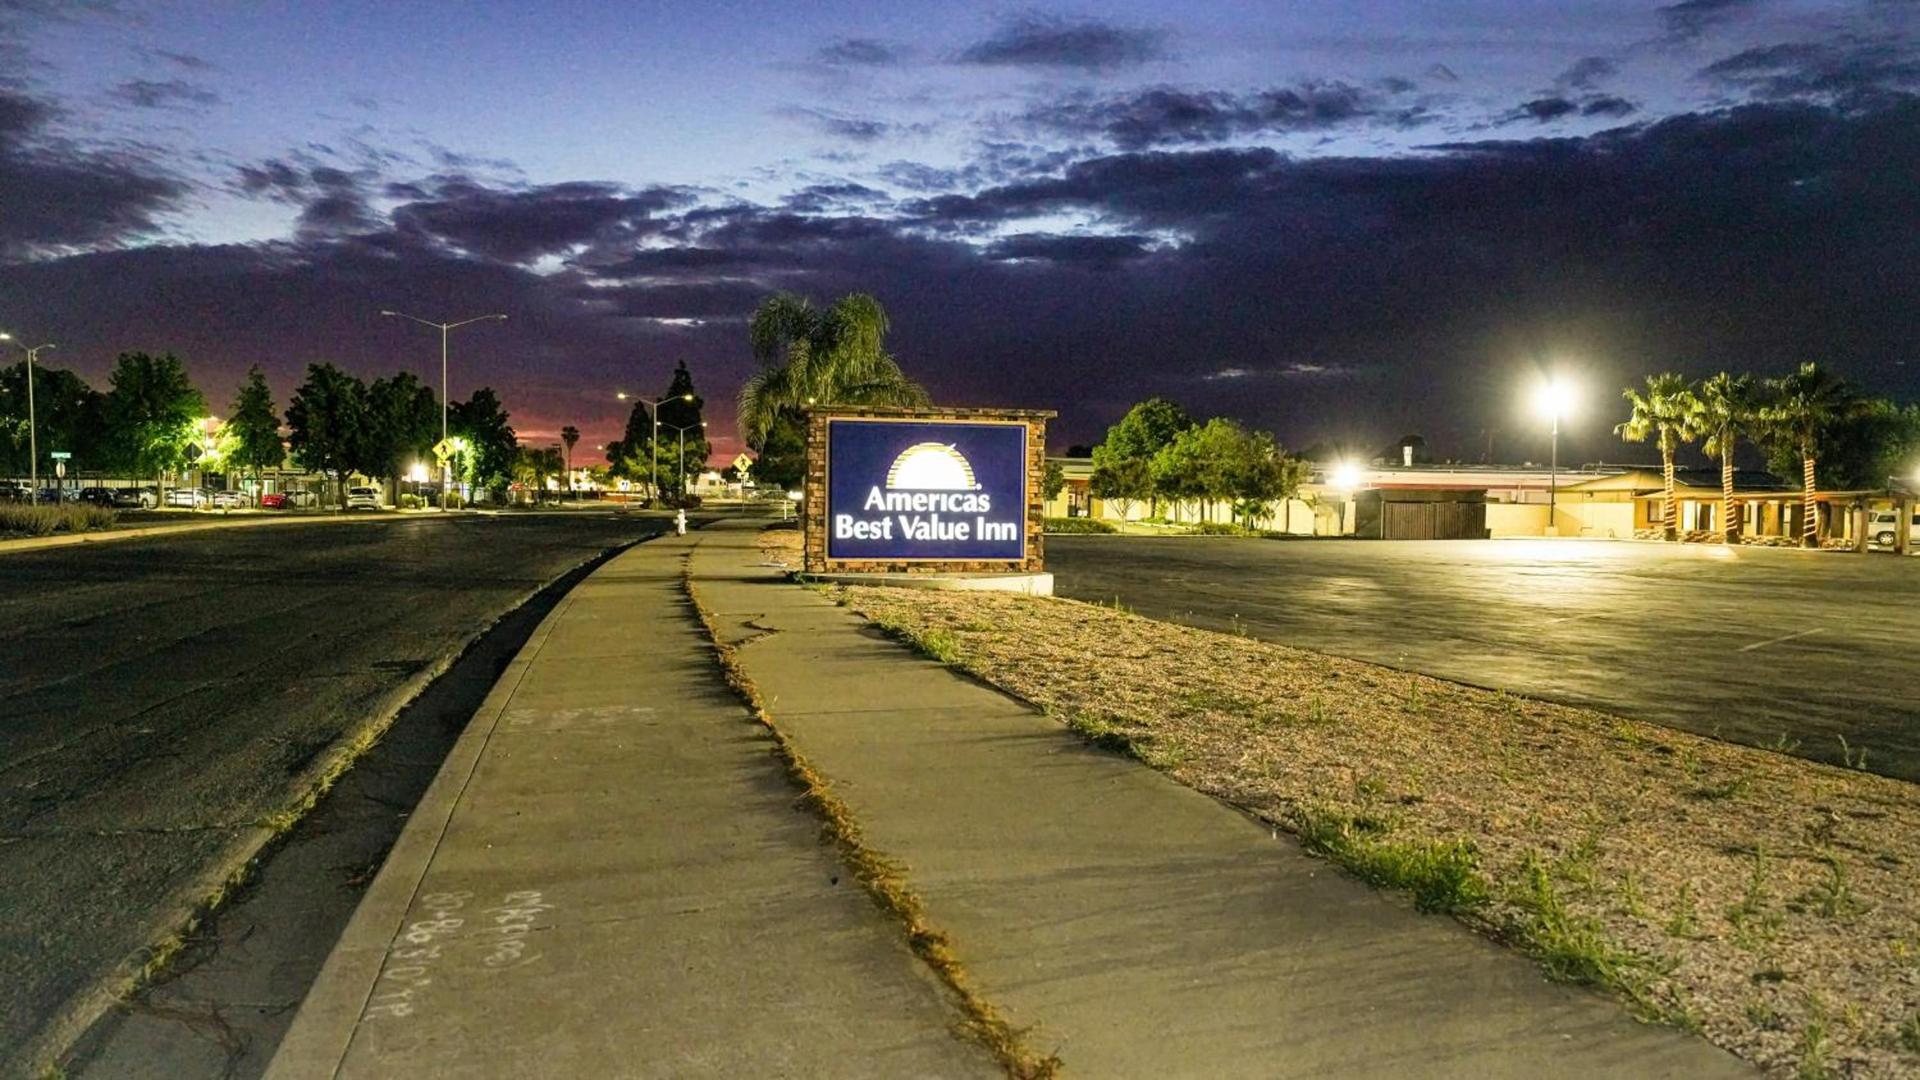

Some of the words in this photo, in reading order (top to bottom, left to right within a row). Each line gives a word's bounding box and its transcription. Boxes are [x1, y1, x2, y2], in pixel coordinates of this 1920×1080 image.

[864, 486, 991, 512] Americas
[835, 515, 893, 540] Best
[899, 515, 969, 541] Value
[977, 517, 1018, 541] Inn
